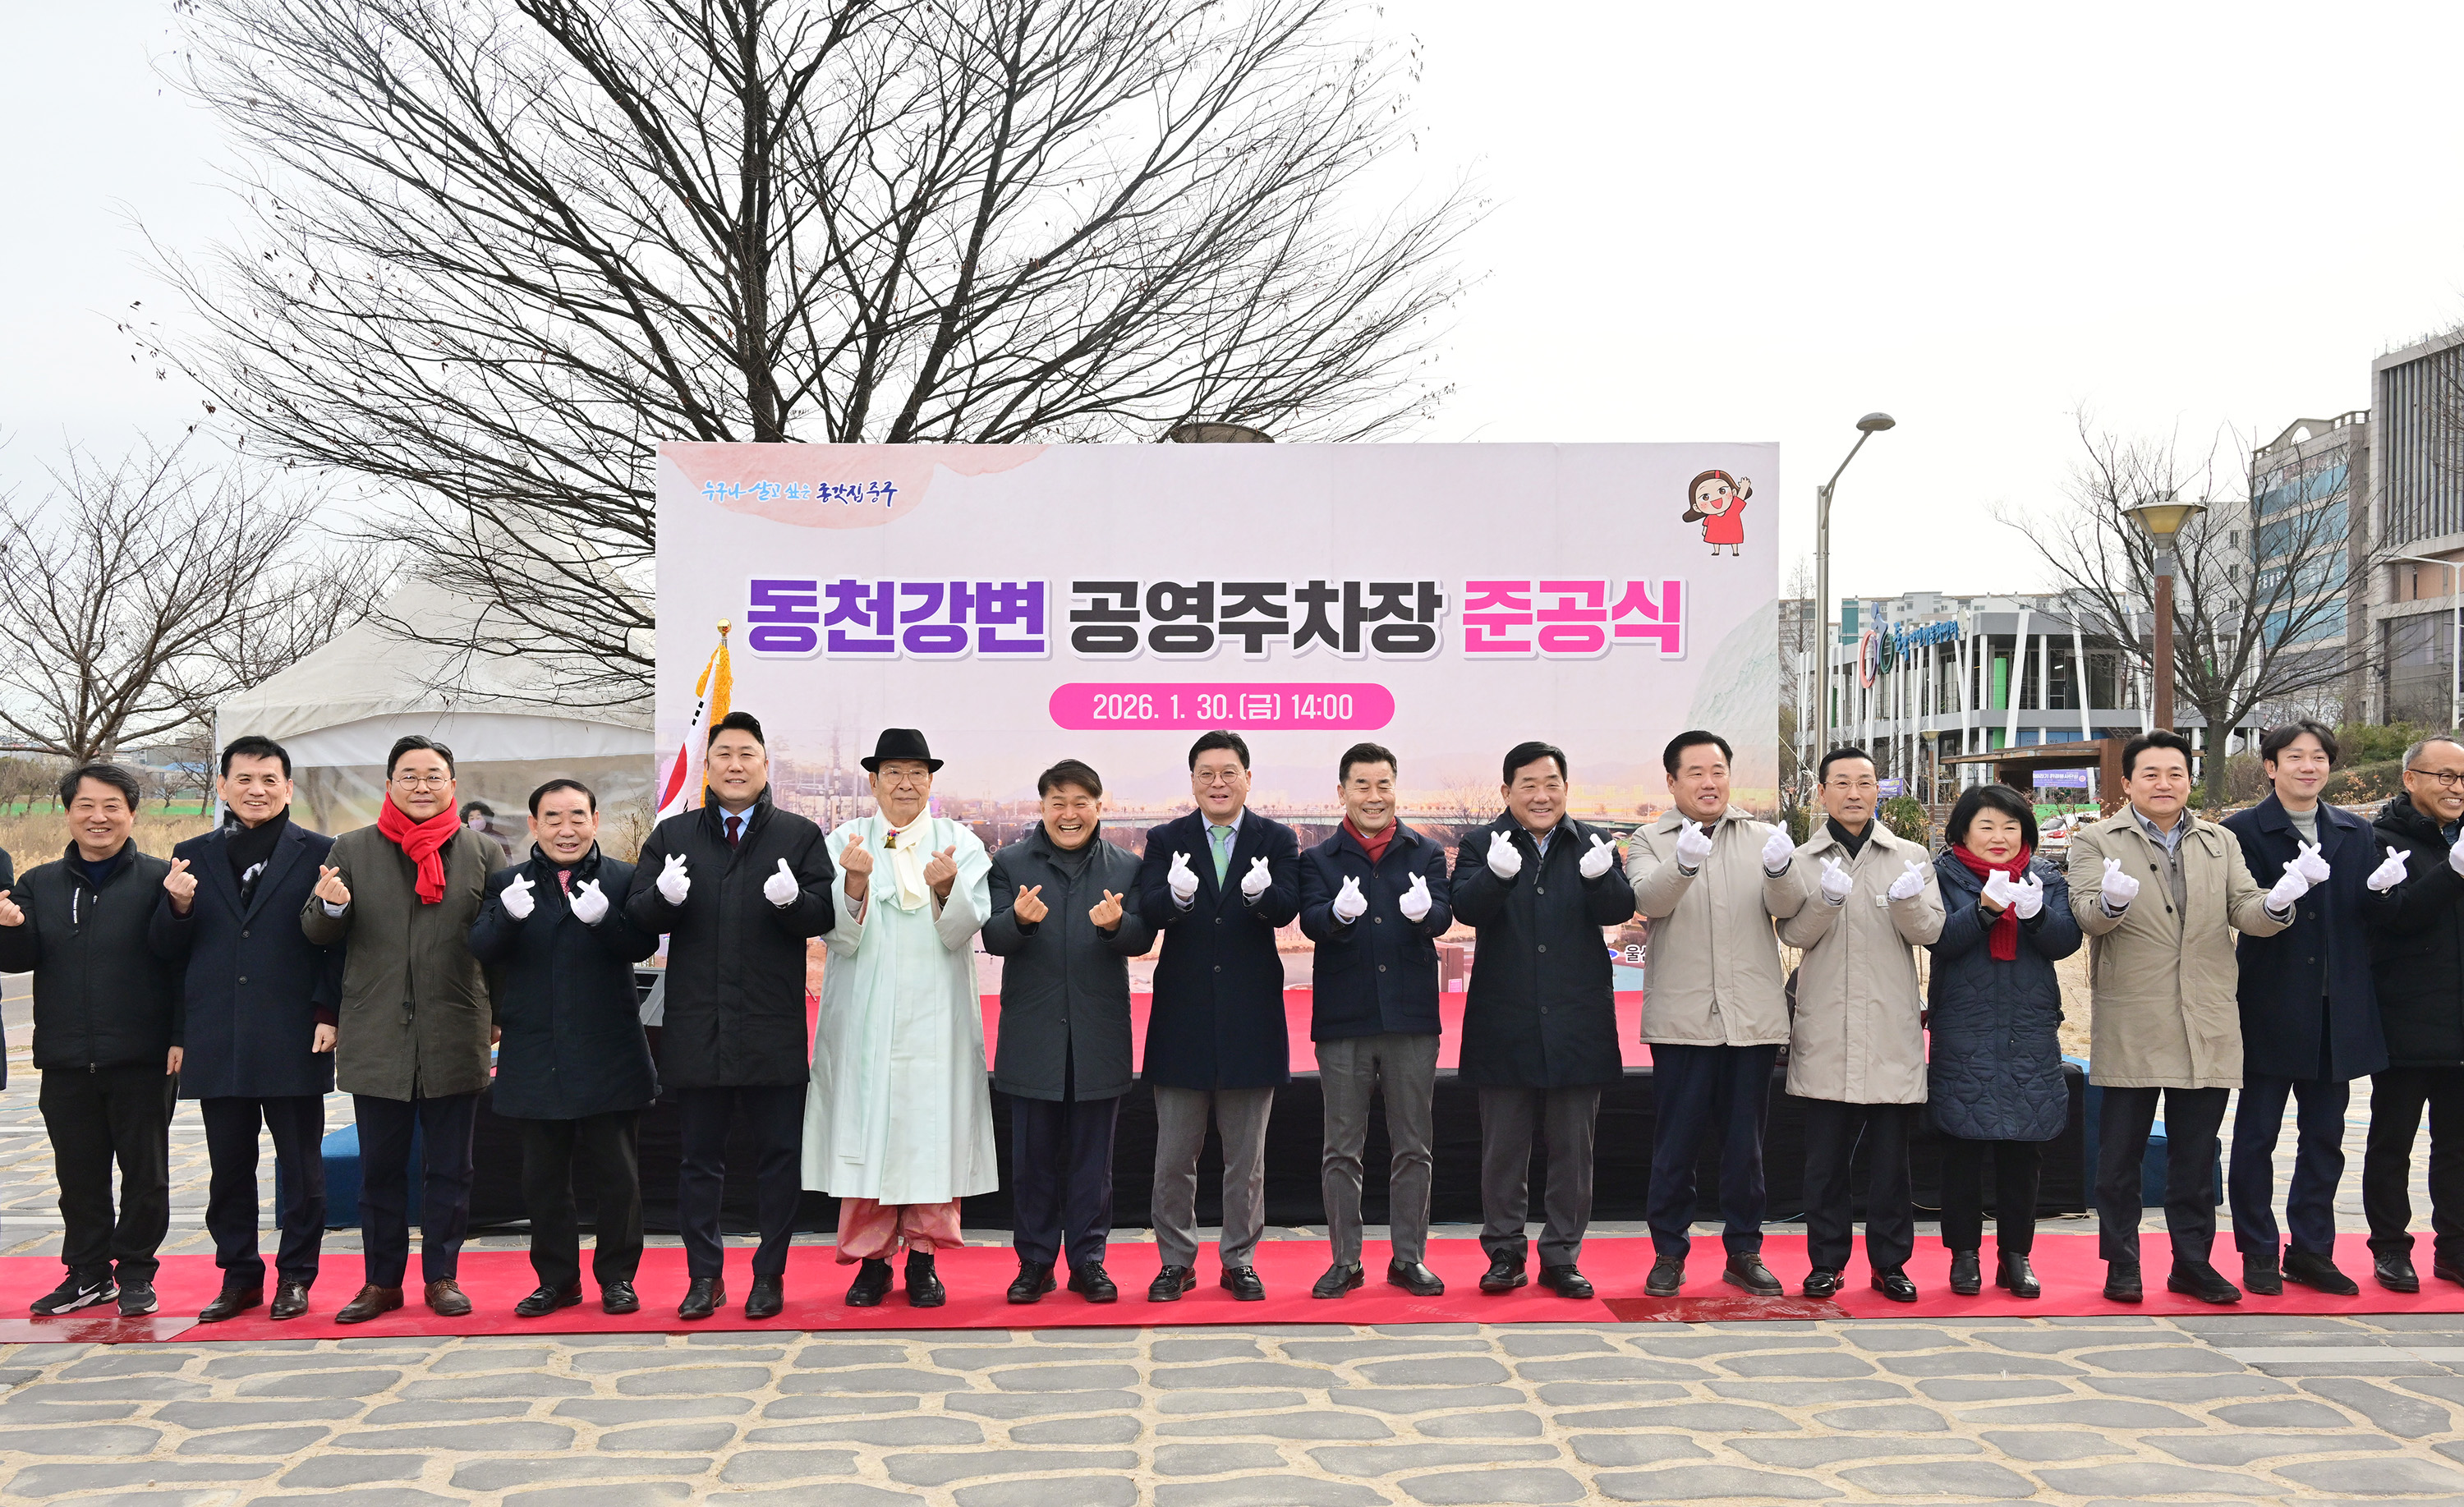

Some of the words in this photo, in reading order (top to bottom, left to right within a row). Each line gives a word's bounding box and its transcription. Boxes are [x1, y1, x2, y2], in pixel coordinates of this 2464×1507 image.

[701, 481, 747, 501] 누구나
[748, 480, 781, 501] 살고
[784, 482, 811, 500] 싶은
[816, 482, 863, 504] 종갓집
[866, 481, 898, 507] 중구
[747, 579, 1045, 653] 동천강변
[1069, 580, 1443, 653] 공영주차장
[1463, 581, 1680, 653] 준공식
[1093, 694, 1159, 719] 2026.
[1170, 694, 1185, 719] 1.
[1291, 694, 1353, 719] 14:00
